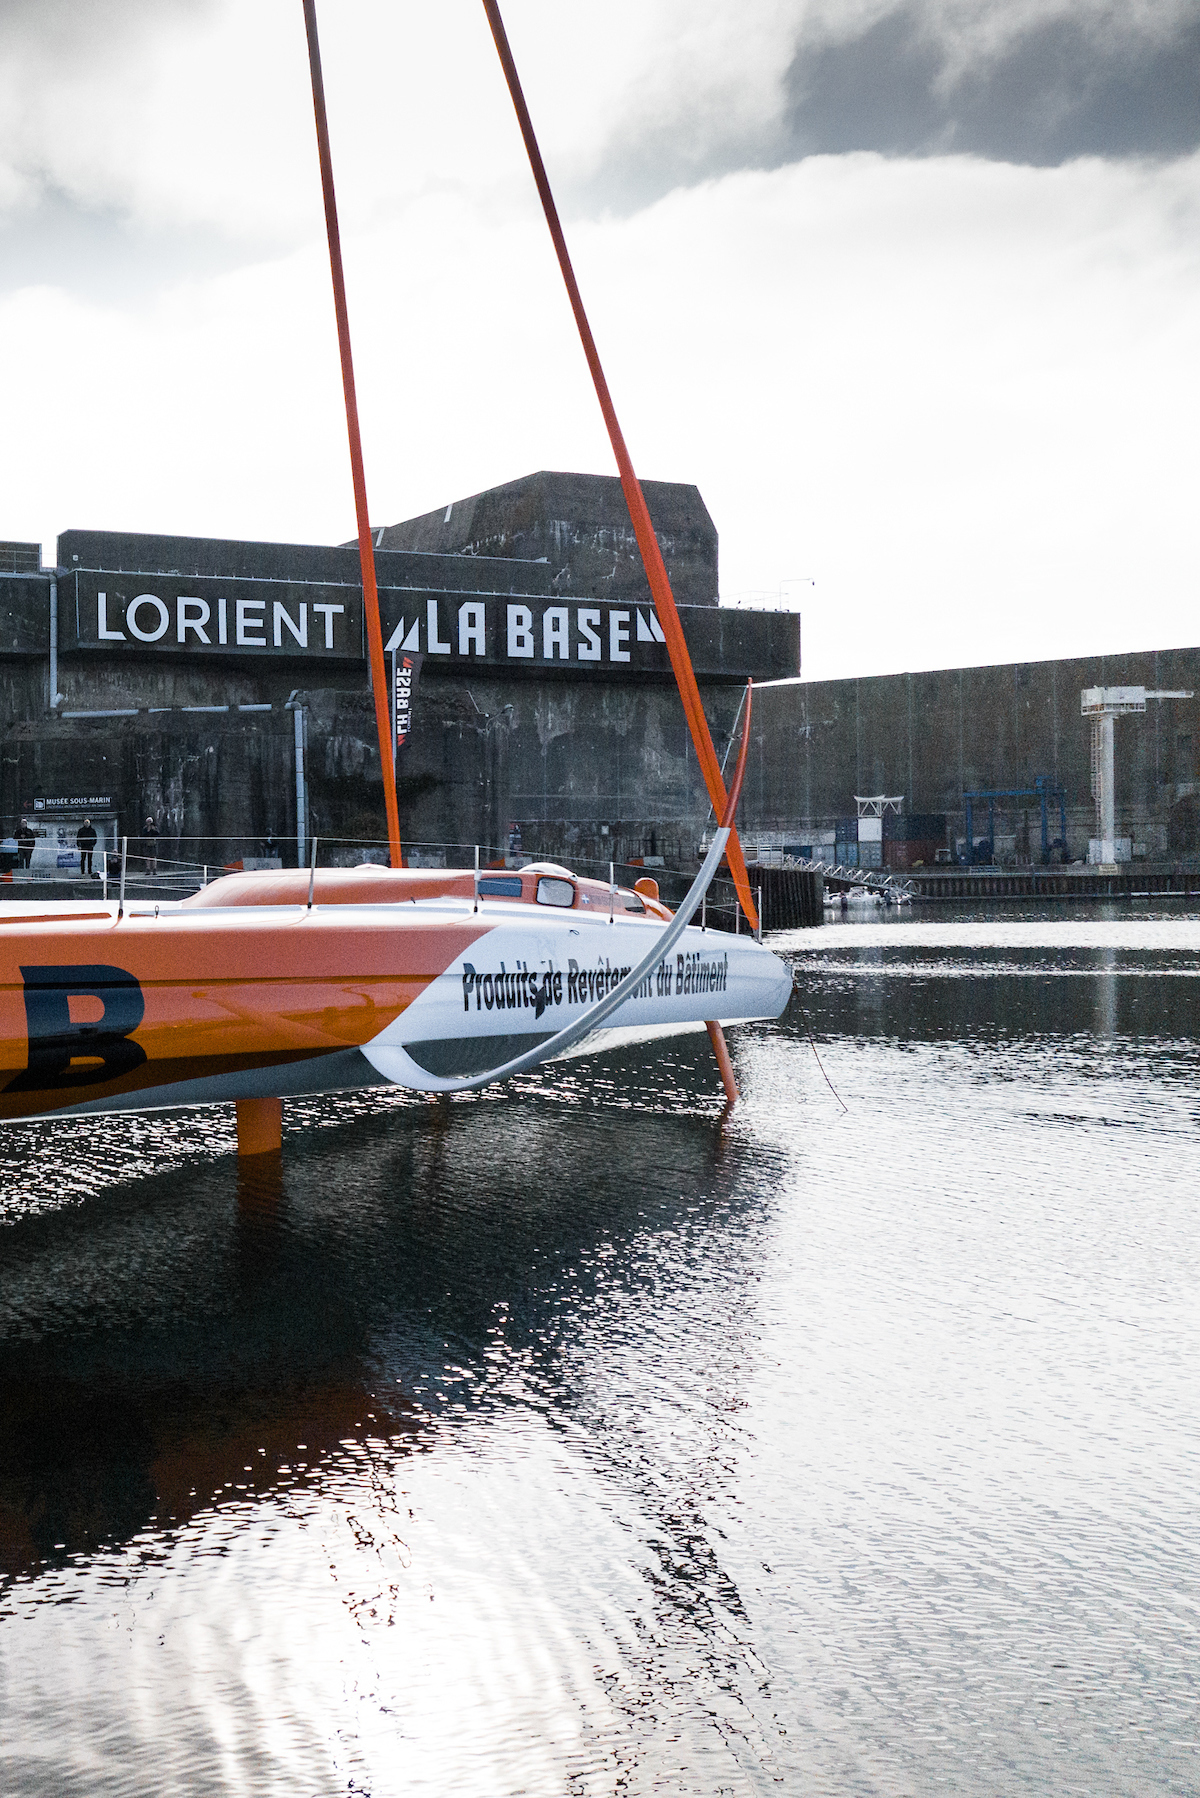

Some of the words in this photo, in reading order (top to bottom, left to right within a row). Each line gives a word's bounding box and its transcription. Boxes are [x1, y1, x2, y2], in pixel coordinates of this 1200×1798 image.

[98, 592, 345, 649] LORIENT
[427, 599, 486, 656] LA
[507, 604, 631, 663] BASE
[463, 960, 539, 1011] Produits
[543, 960, 562, 1006] de
[568, 956, 652, 1004] Revêtent
[657, 959, 673, 997] du
[676, 952, 728, 995] Bâtiment
